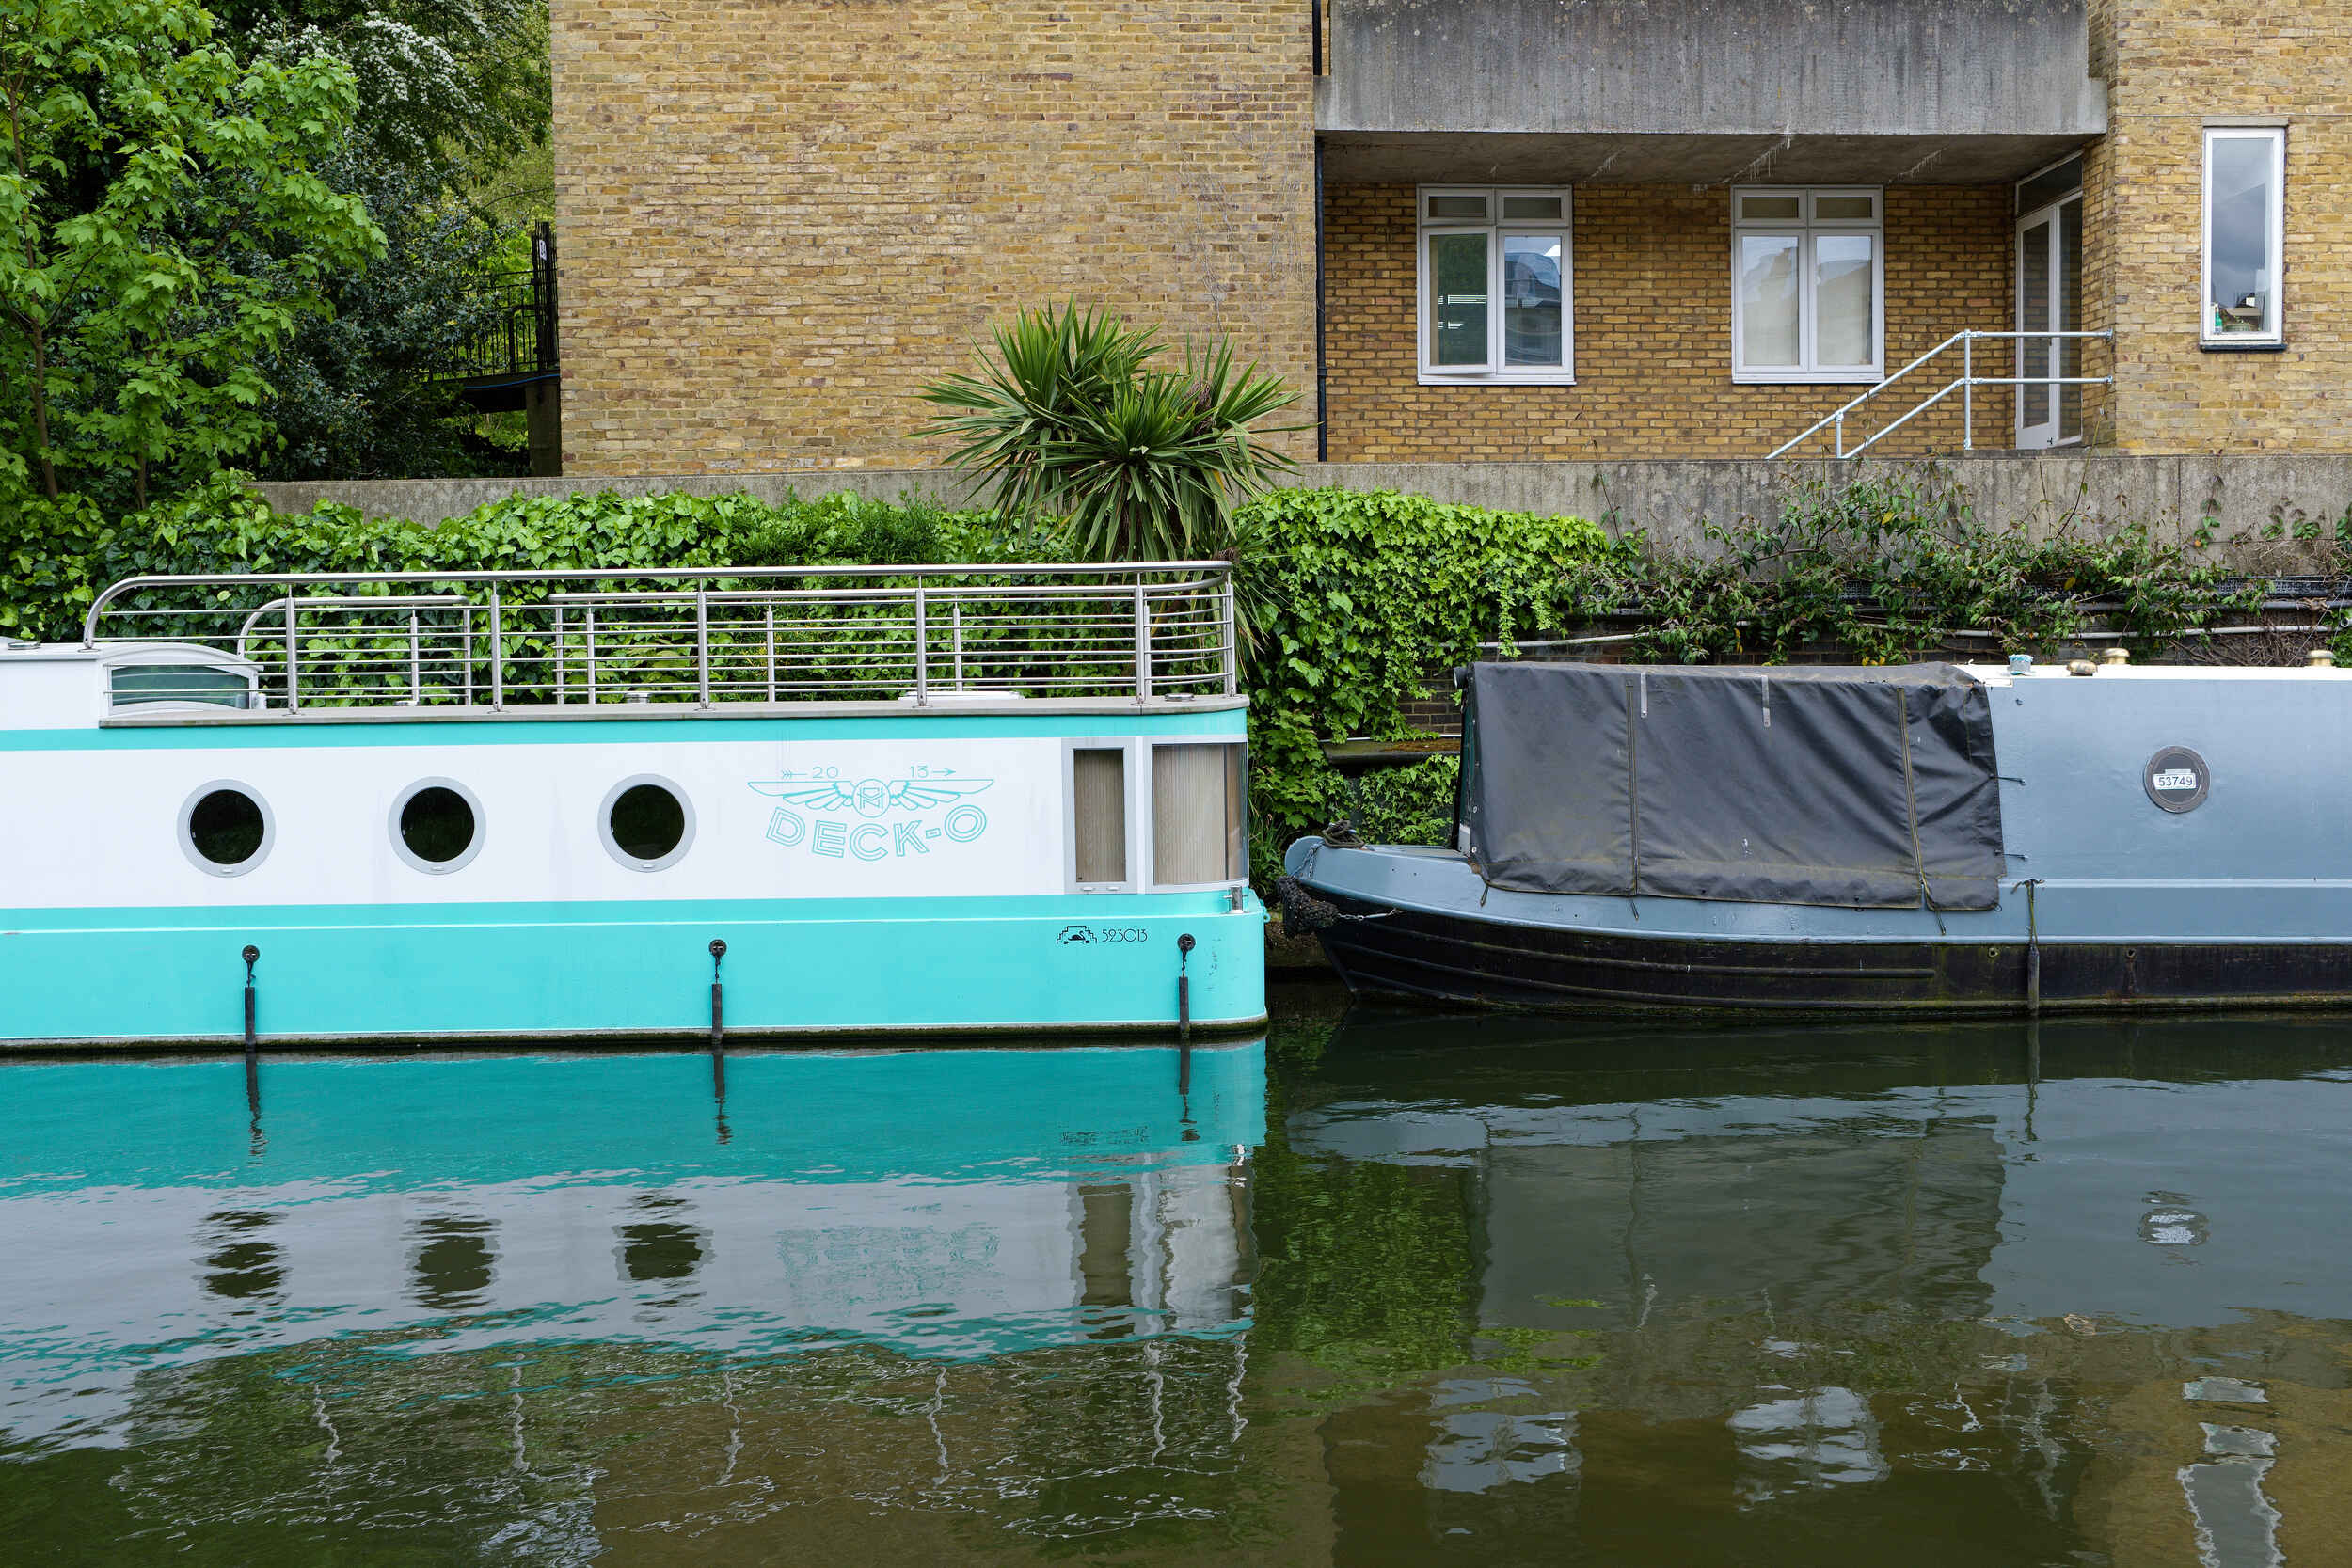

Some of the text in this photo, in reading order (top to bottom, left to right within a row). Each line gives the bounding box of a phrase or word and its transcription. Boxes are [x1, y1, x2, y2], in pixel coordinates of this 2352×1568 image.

[812, 765, 929, 779] 20 13
[2158, 776, 2193, 786] 53749
[766, 804, 987, 861] DECK-O
